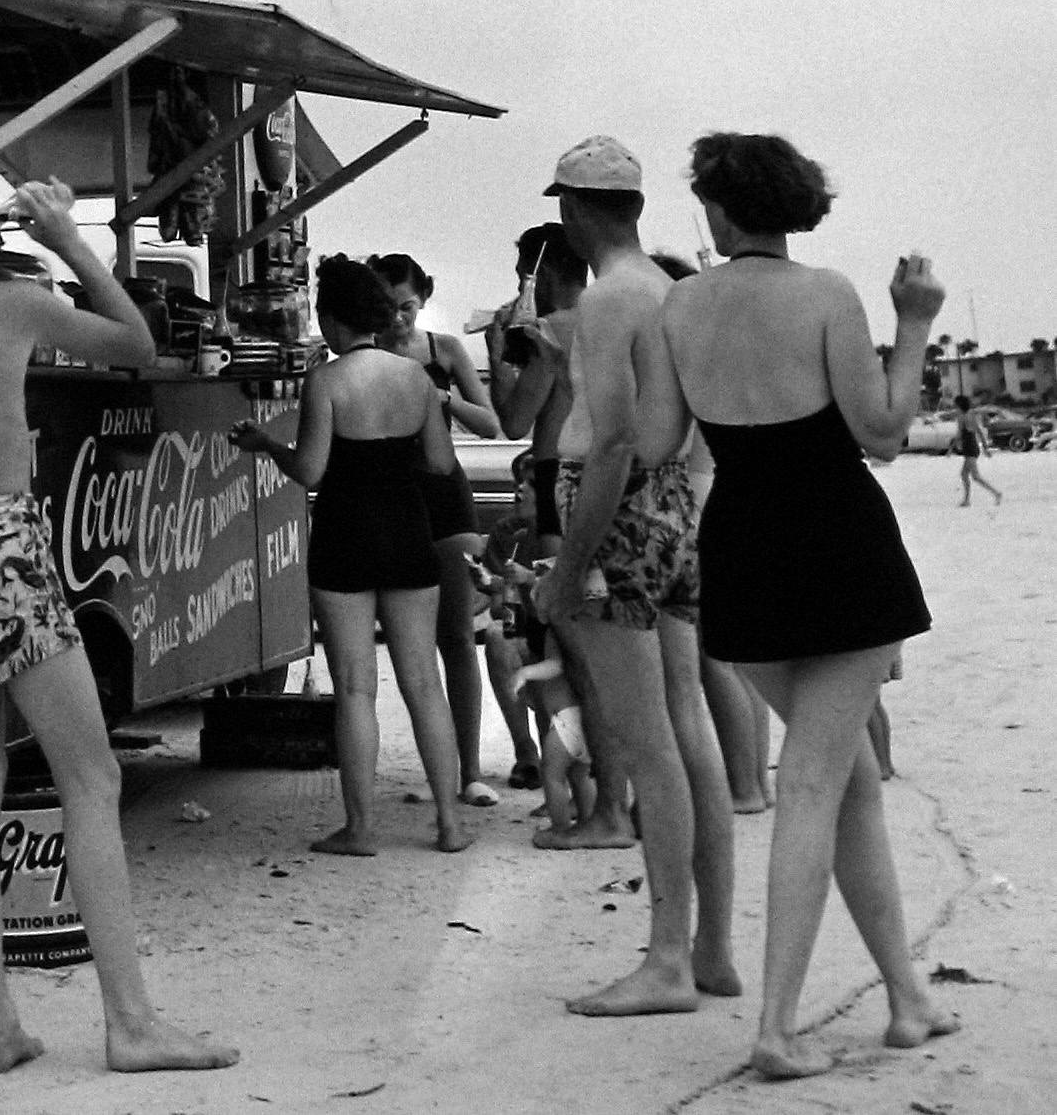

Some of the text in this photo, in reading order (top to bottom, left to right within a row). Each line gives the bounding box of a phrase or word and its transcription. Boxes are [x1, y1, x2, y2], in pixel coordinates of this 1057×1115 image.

[101, 407, 155, 436] DRINK
[62, 431, 206, 593] Coca-Cola
[210, 474, 250, 538] DRINKS
[267, 520, 300, 578] FILM
[186, 558, 255, 645] SANDWICHES
[149, 615, 181, 667] BALLS
[2, 912, 83, 930] TATION GRA
[4, 950, 44, 962] APETTE
